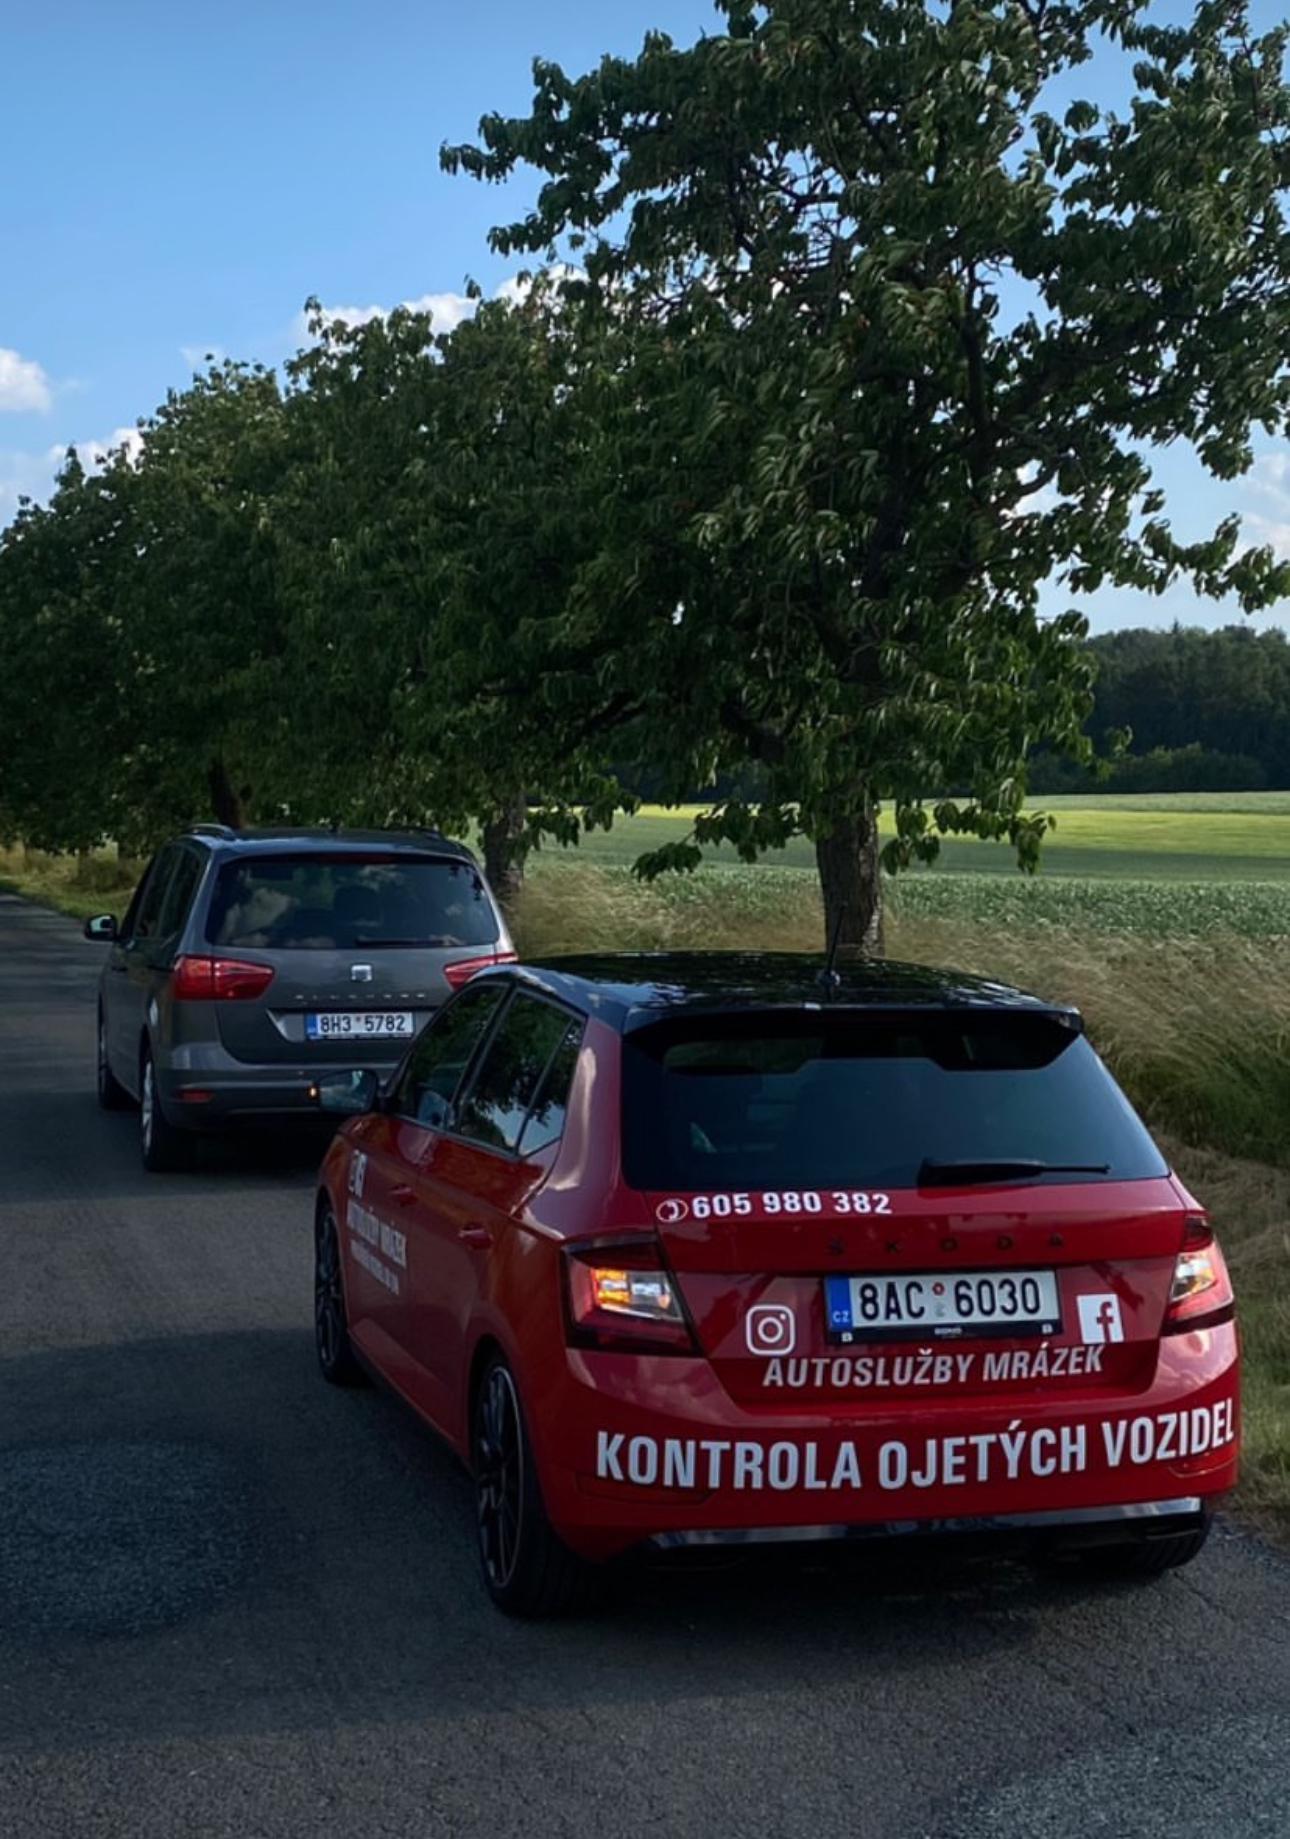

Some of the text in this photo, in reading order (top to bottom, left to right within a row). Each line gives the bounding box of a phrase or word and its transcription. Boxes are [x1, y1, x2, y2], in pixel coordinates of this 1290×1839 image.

[320, 1014, 405, 1033] 8H3 5782
[692, 1192, 893, 1219] 605 980 382
[832, 1310, 850, 1323] CZ
[859, 1277, 1041, 1321] 8AC 6030
[762, 1342, 1104, 1388] AUTOSLUŽBY MRÁZEK
[597, 1397, 1235, 1490] KONTROLA OJETÝCH VOZIDEL
